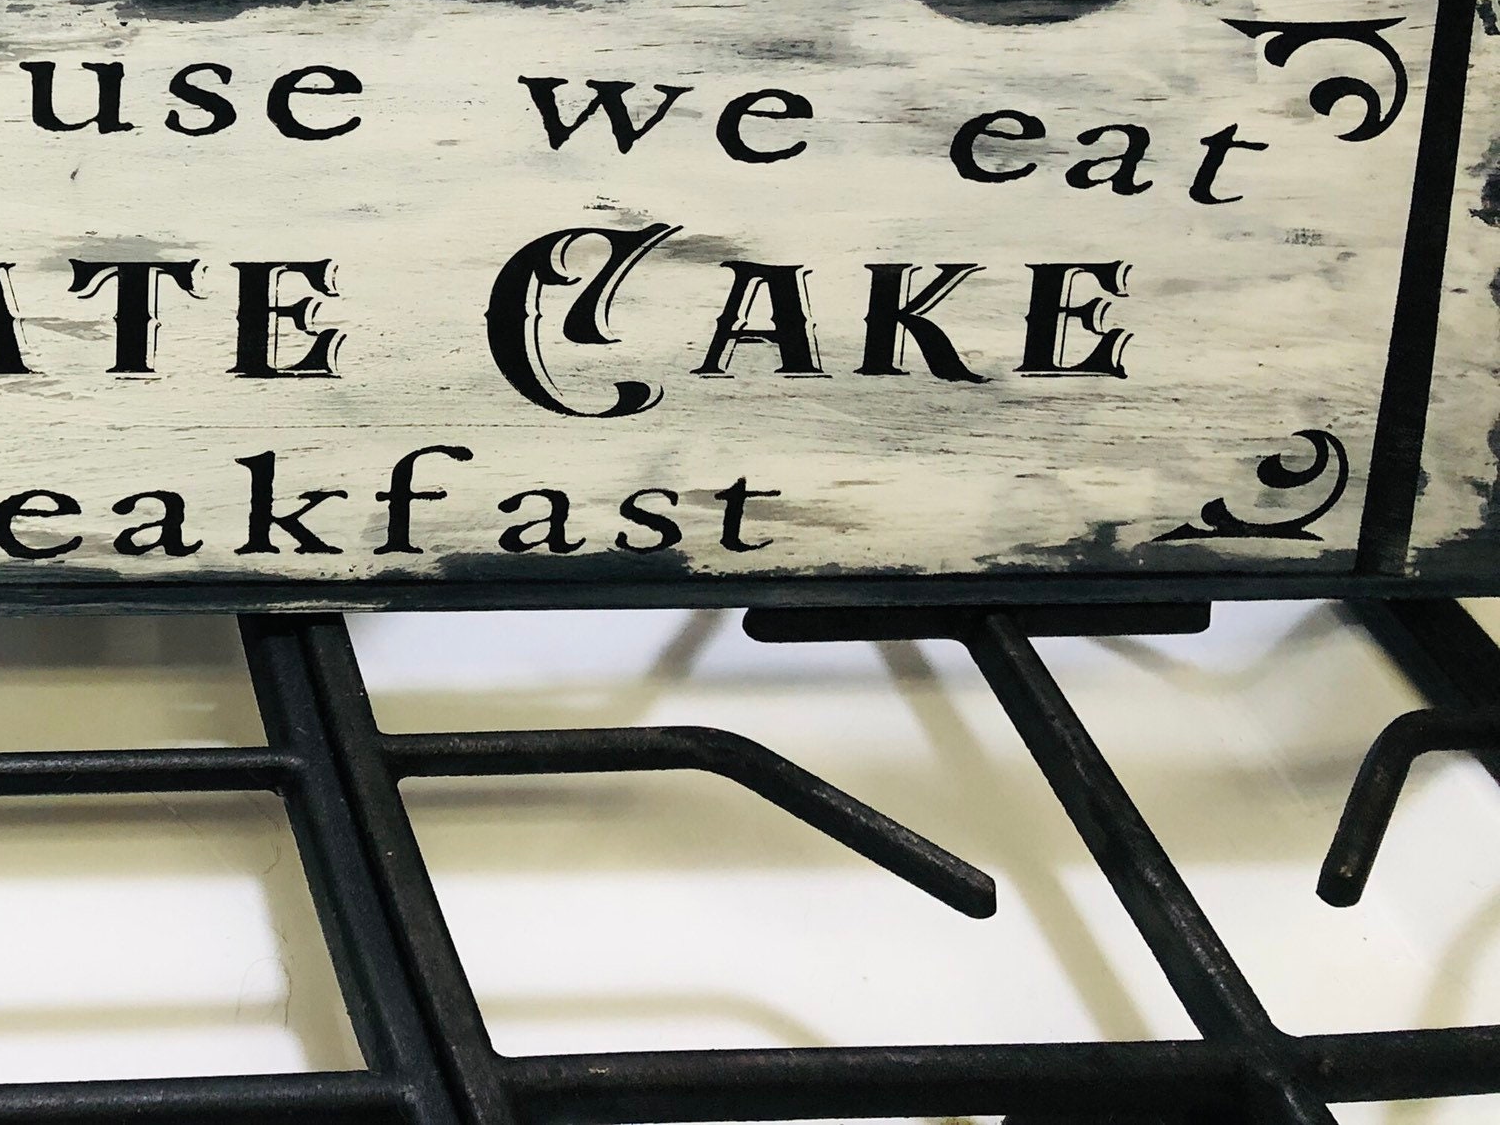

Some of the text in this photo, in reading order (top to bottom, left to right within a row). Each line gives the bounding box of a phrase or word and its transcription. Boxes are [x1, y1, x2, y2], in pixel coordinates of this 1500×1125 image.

[518, 74, 815, 165] we
[950, 108, 1271, 206] eat
[483, 221, 1136, 419] CAKE
